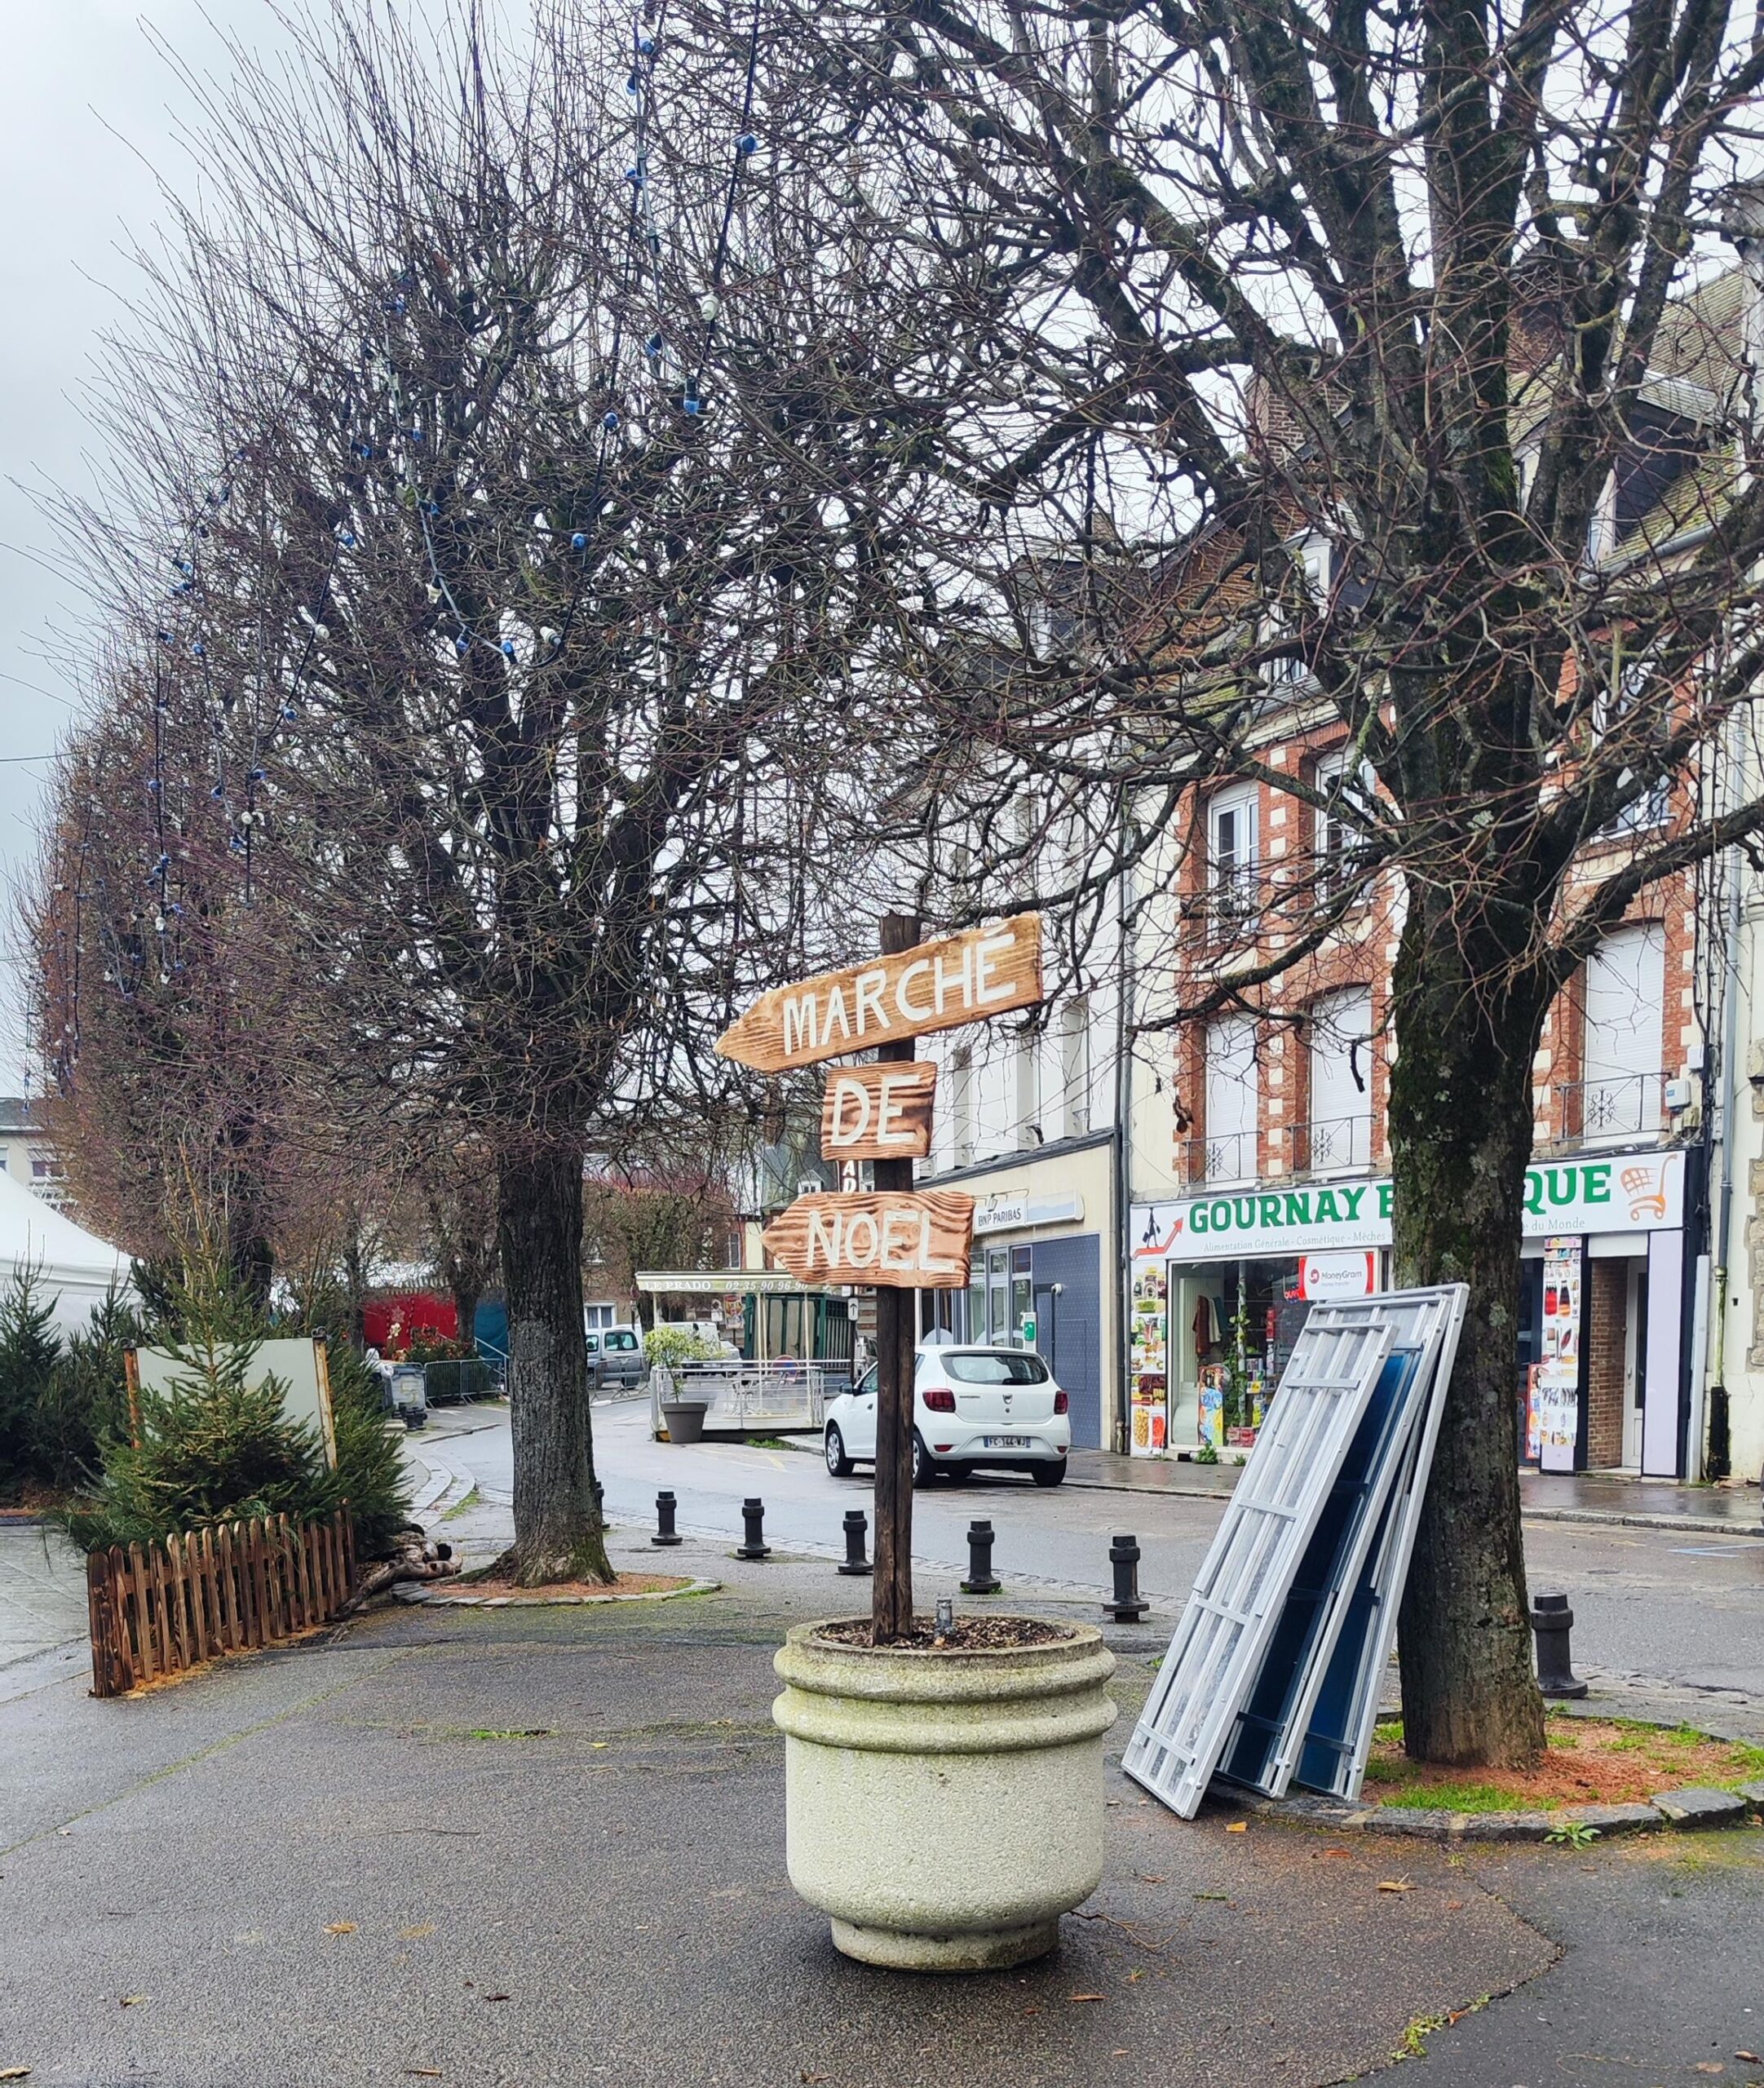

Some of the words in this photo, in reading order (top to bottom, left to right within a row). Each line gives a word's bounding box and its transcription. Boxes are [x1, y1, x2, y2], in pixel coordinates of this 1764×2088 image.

[830, 1074, 920, 1146] DE
[978, 1214, 993, 1227] BNP
[993, 1207, 1022, 1223] PARIBAS
[1189, 1186, 1367, 1233] GOURNAY
[1204, 1239, 1253, 1253] Alimentation
[1254, 1236, 1290, 1249] Générale
[1296, 1233, 1345, 1246] Cosmétique
[1353, 1230, 1386, 1241] Mèches
[1532, 1219, 1545, 1231] du
[1548, 1216, 1585, 1230] Monde
[645, 1281, 662, 1290] LE
[665, 1280, 711, 1290] PRADO
[1321, 1269, 1363, 1281] MoneyGram
